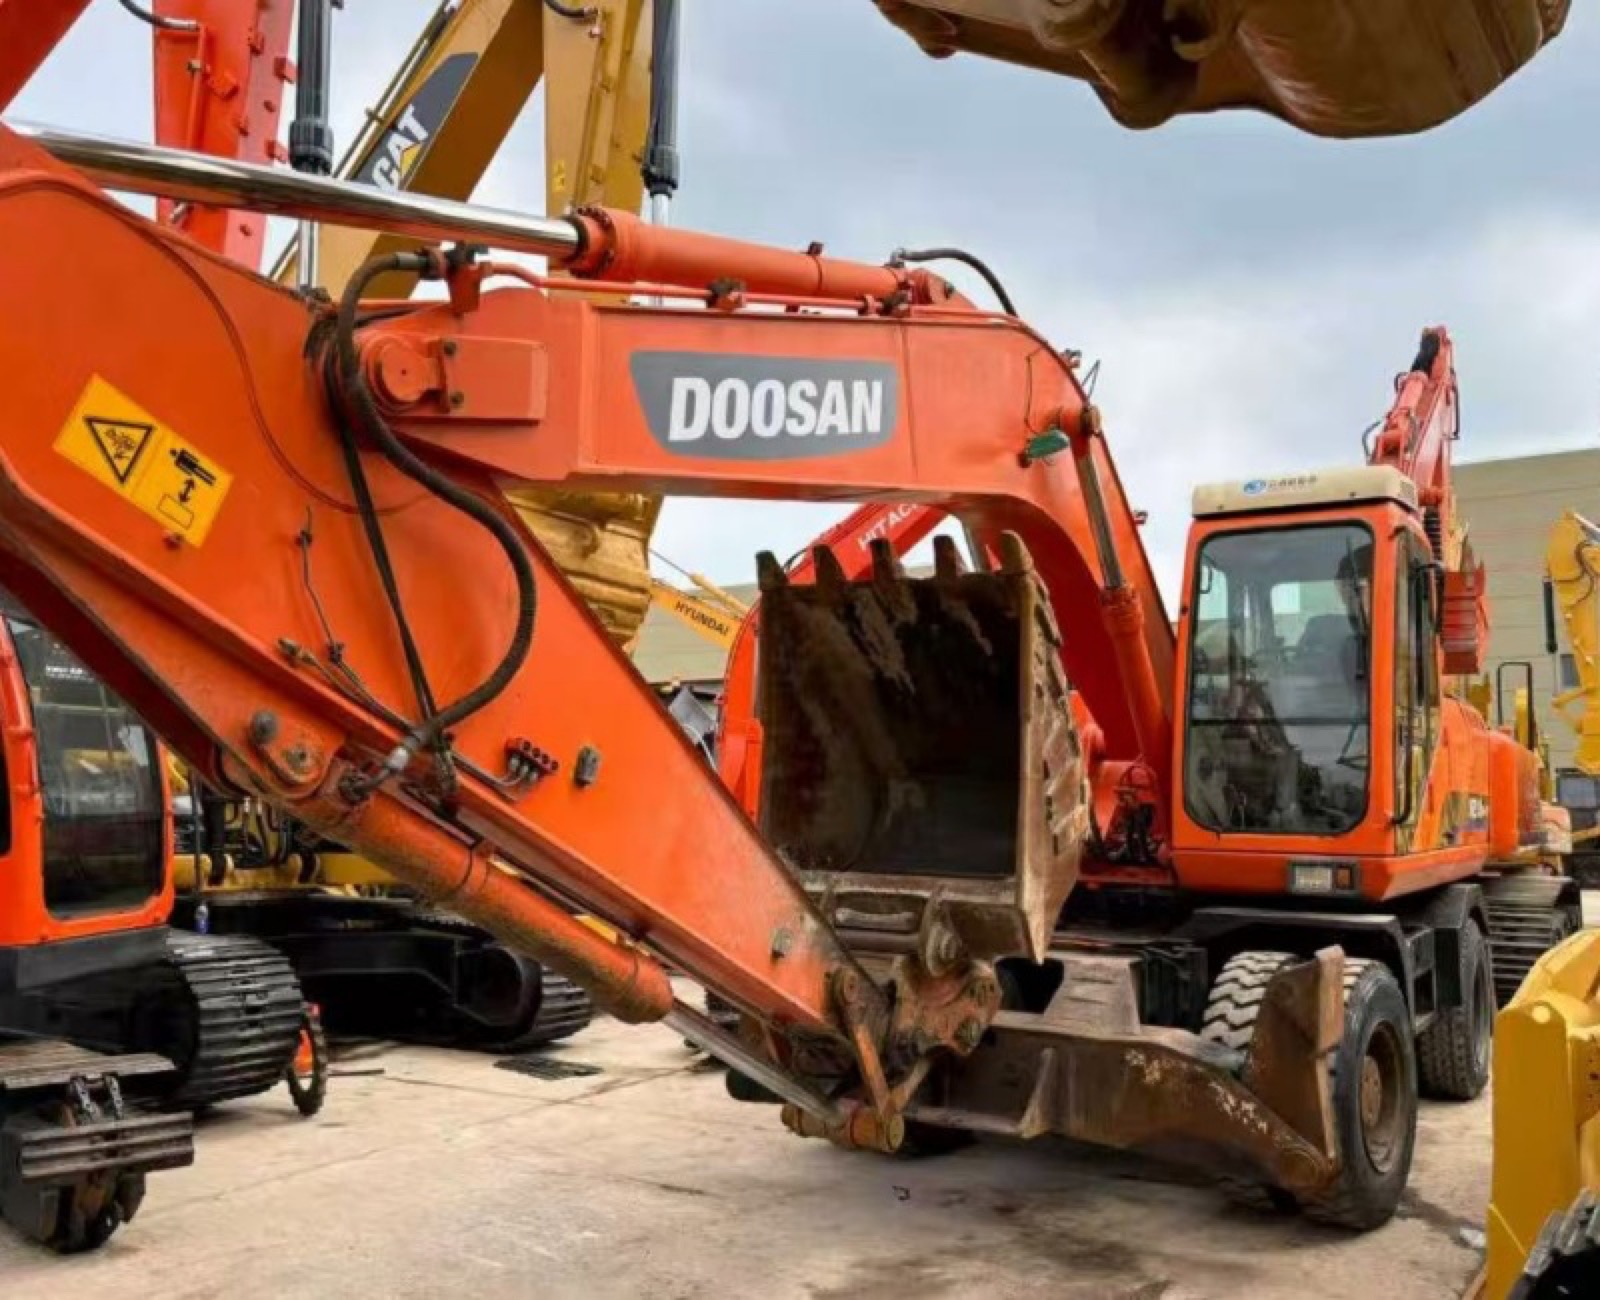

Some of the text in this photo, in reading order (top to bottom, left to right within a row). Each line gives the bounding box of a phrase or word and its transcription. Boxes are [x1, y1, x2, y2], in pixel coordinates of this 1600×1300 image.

[371, 104, 429, 190] CAT
[668, 377, 883, 441] DOOSAN
[857, 503, 918, 552] HITAC
[675, 601, 729, 636] HYUNDAI
